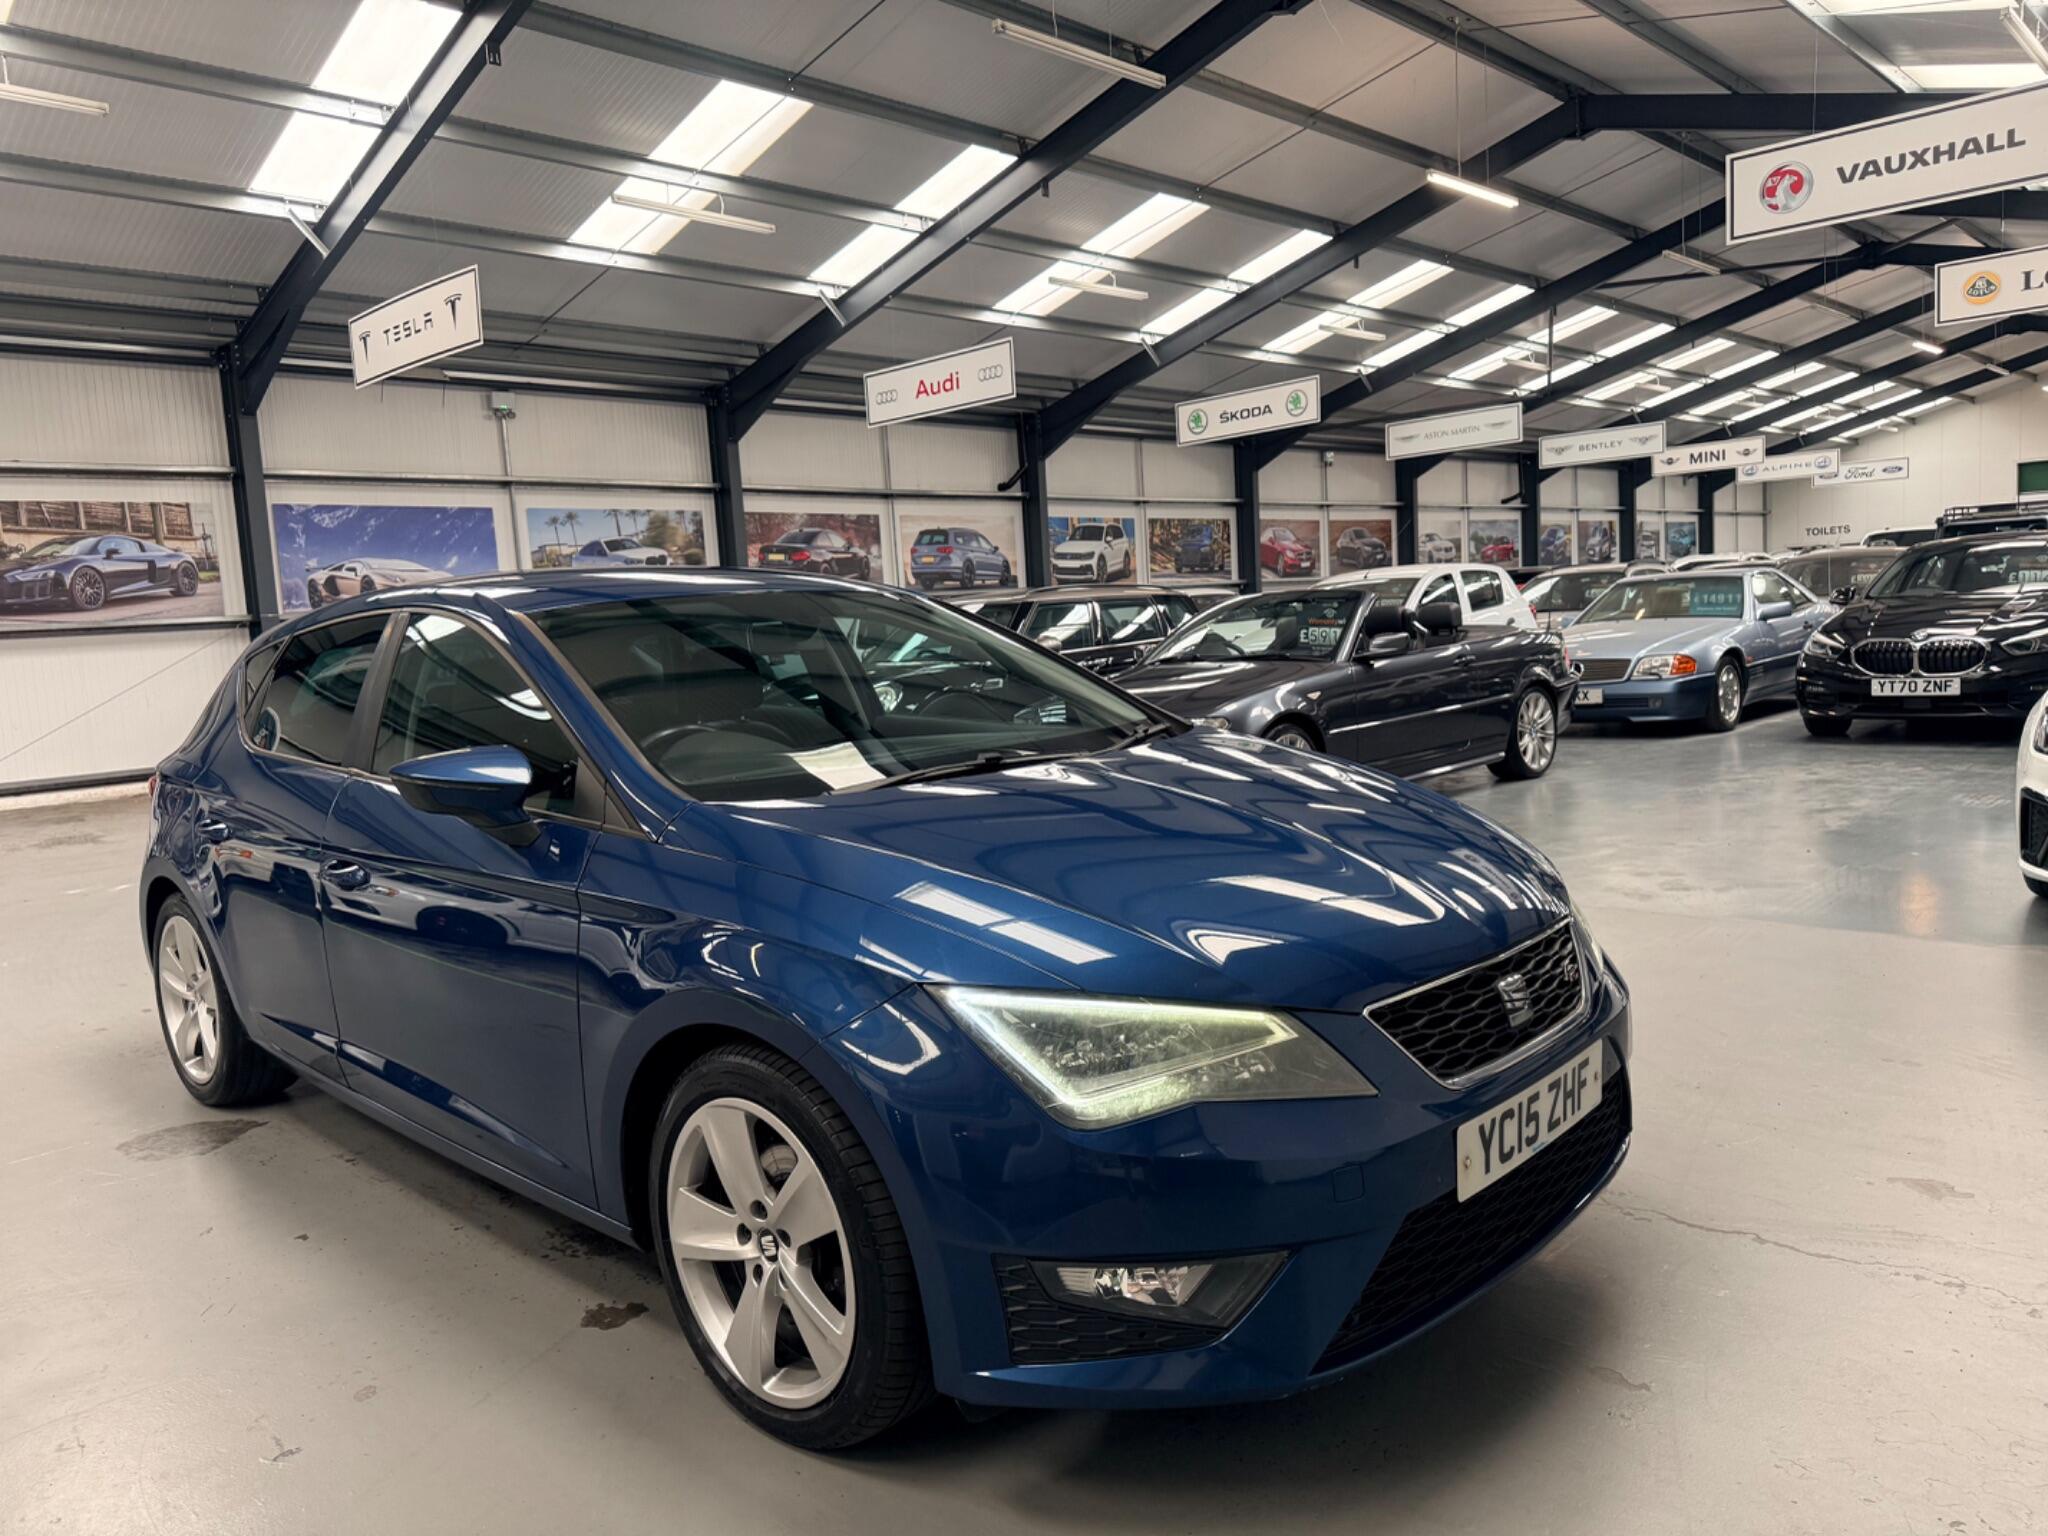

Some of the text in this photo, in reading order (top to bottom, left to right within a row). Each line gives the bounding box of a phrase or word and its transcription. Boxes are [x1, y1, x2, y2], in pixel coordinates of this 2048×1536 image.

[1836, 128, 2026, 184] VAUXHALL
[383, 312, 434, 345] TESLA
[915, 371, 961, 399] Audi
[1424, 424, 1481, 440] ASTON MARTIN
[1578, 439, 1624, 452] BENTLEY
[1689, 449, 1727, 465] MINI
[1762, 461, 1813, 473] ALPINE
[1844, 465, 1876, 480] Ford
[1804, 524, 1851, 536] TOILETS
[1878, 680, 1954, 693] YT70 ZNF
[1478, 1056, 1591, 1175] YC15 ZHF
